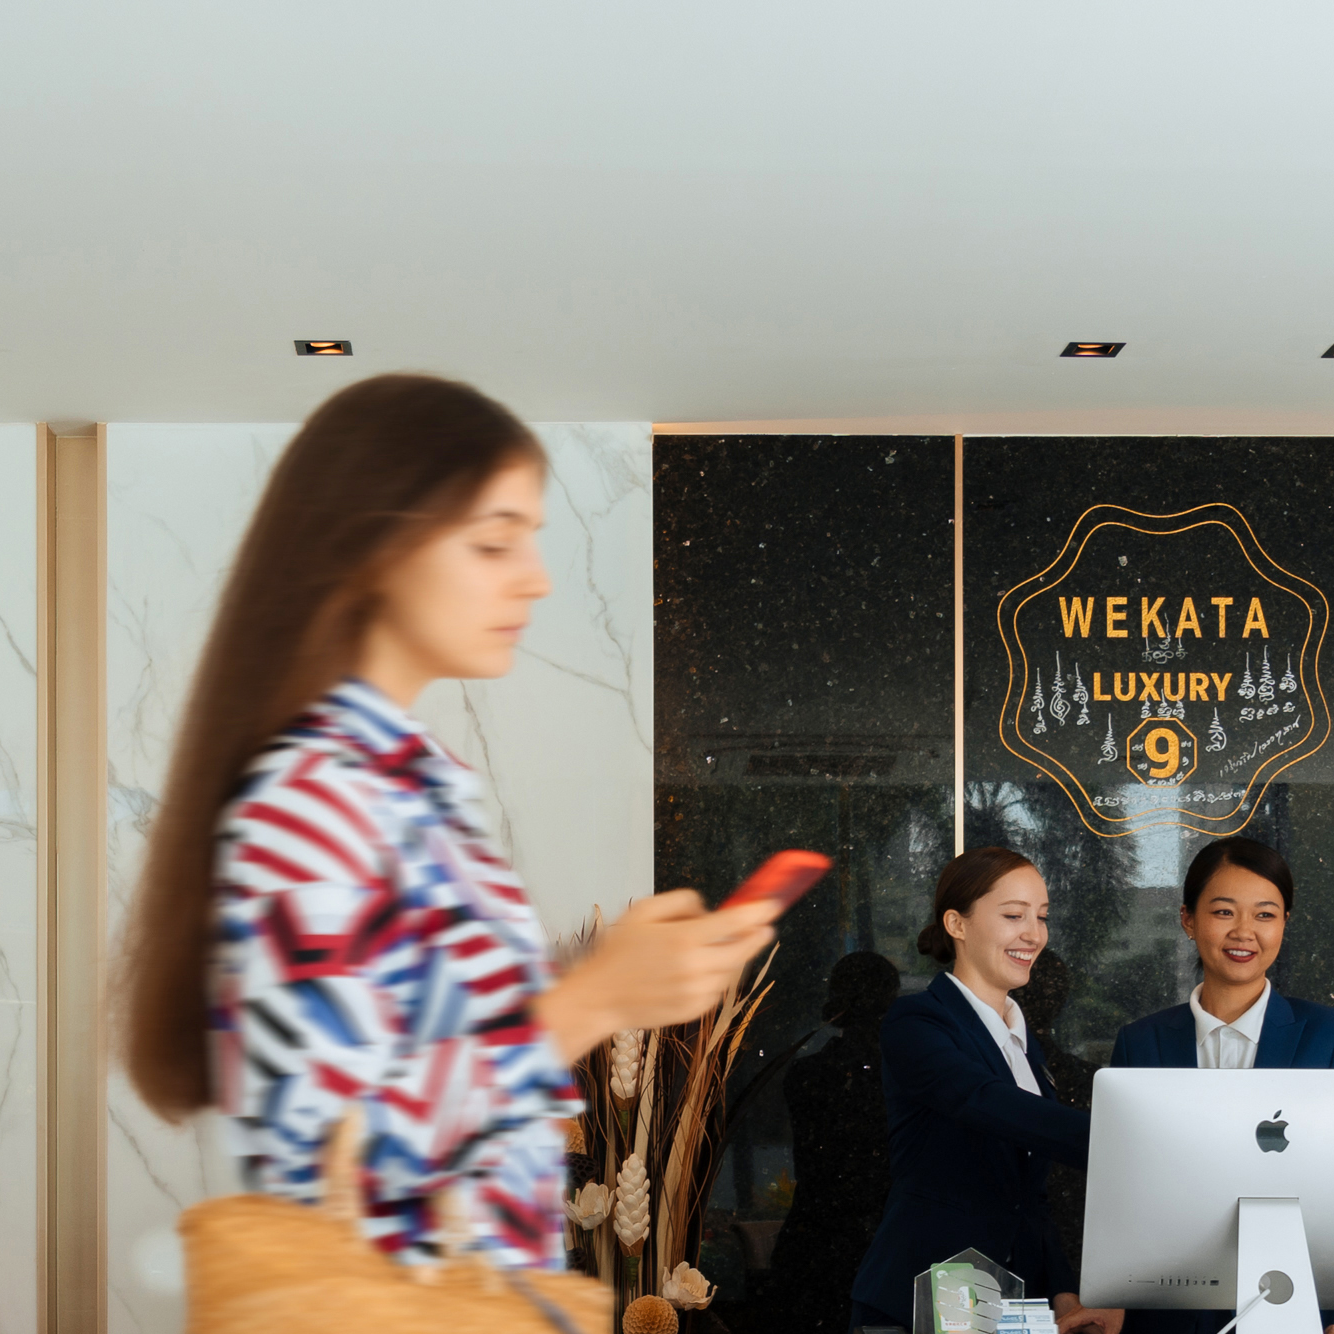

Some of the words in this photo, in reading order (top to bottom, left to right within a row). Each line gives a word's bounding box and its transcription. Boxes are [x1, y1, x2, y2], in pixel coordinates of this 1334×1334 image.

[1059, 597, 1269, 638] WEKATA
[1093, 672, 1233, 701] LUXURY
[1144, 727, 1180, 778] 9
